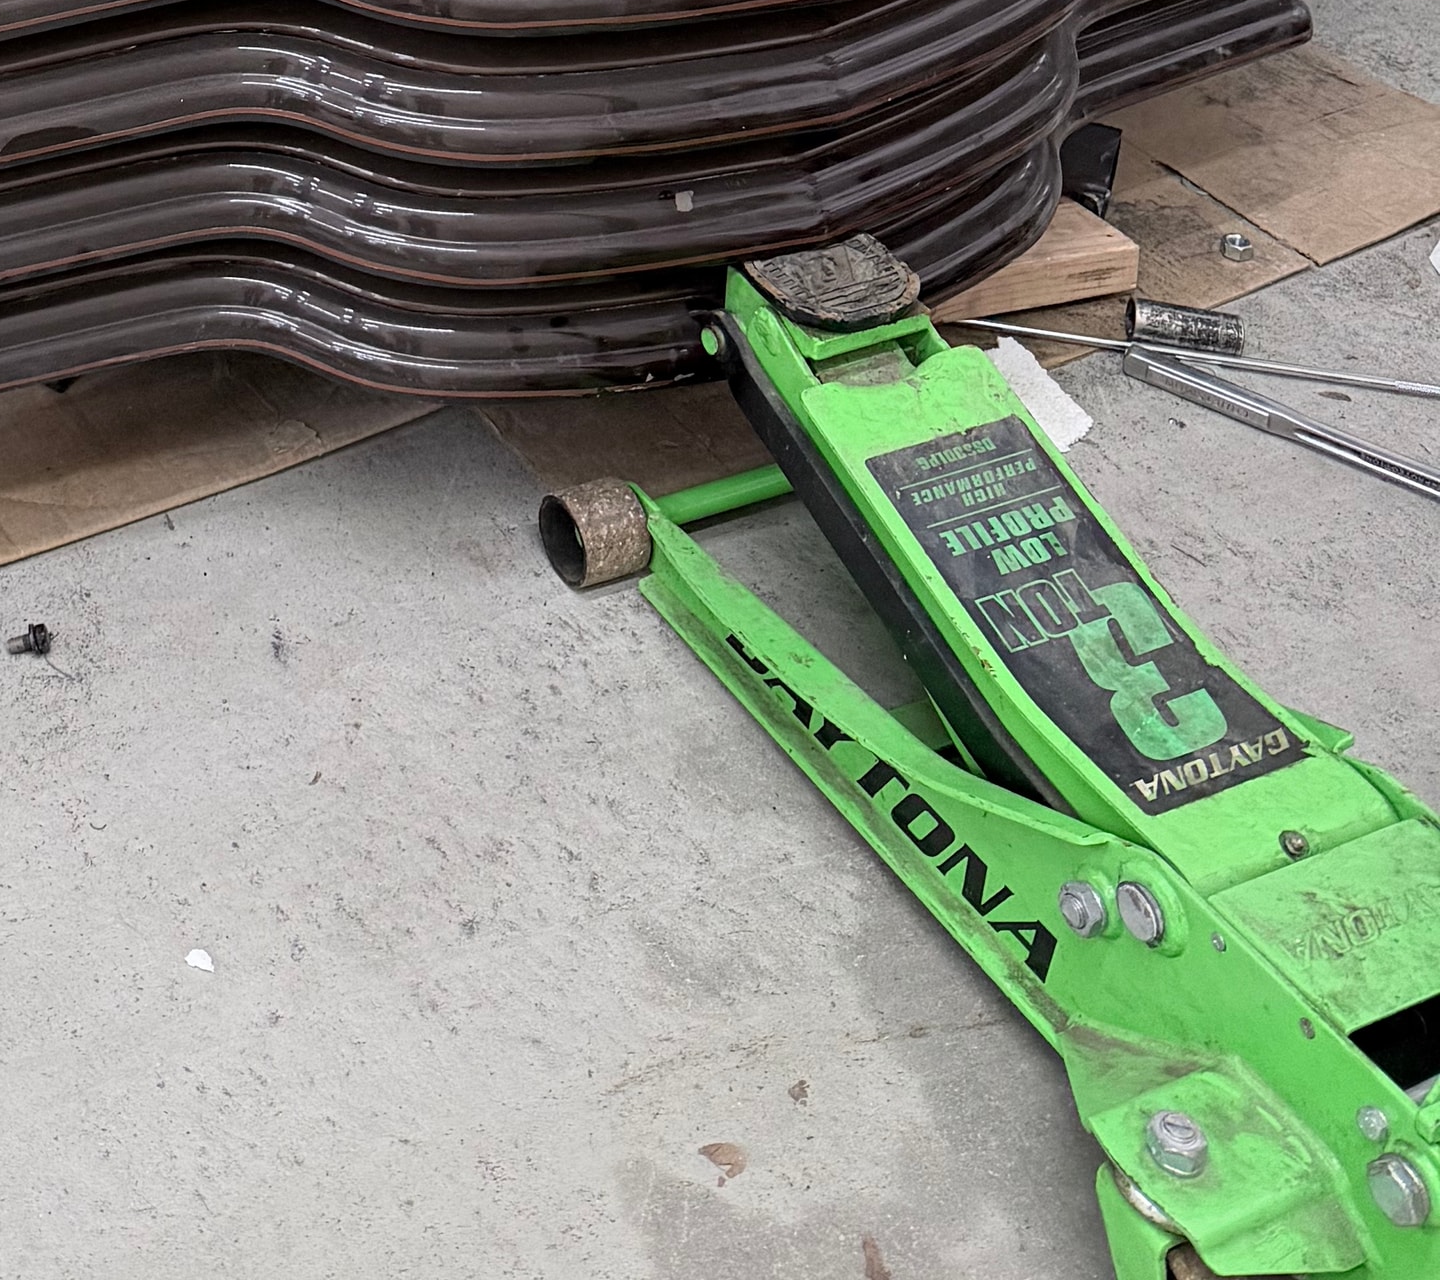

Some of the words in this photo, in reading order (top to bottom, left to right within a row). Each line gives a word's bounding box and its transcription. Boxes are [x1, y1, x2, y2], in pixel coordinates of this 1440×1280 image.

[911, 457, 1038, 506] PERFORMANCE
[961, 482, 1007, 507] HIGH
[938, 495, 1077, 557] PROFILE
[990, 531, 1069, 576] LOW
[974, 568, 1112, 653] TON
[1070, 581, 1229, 762] 3
